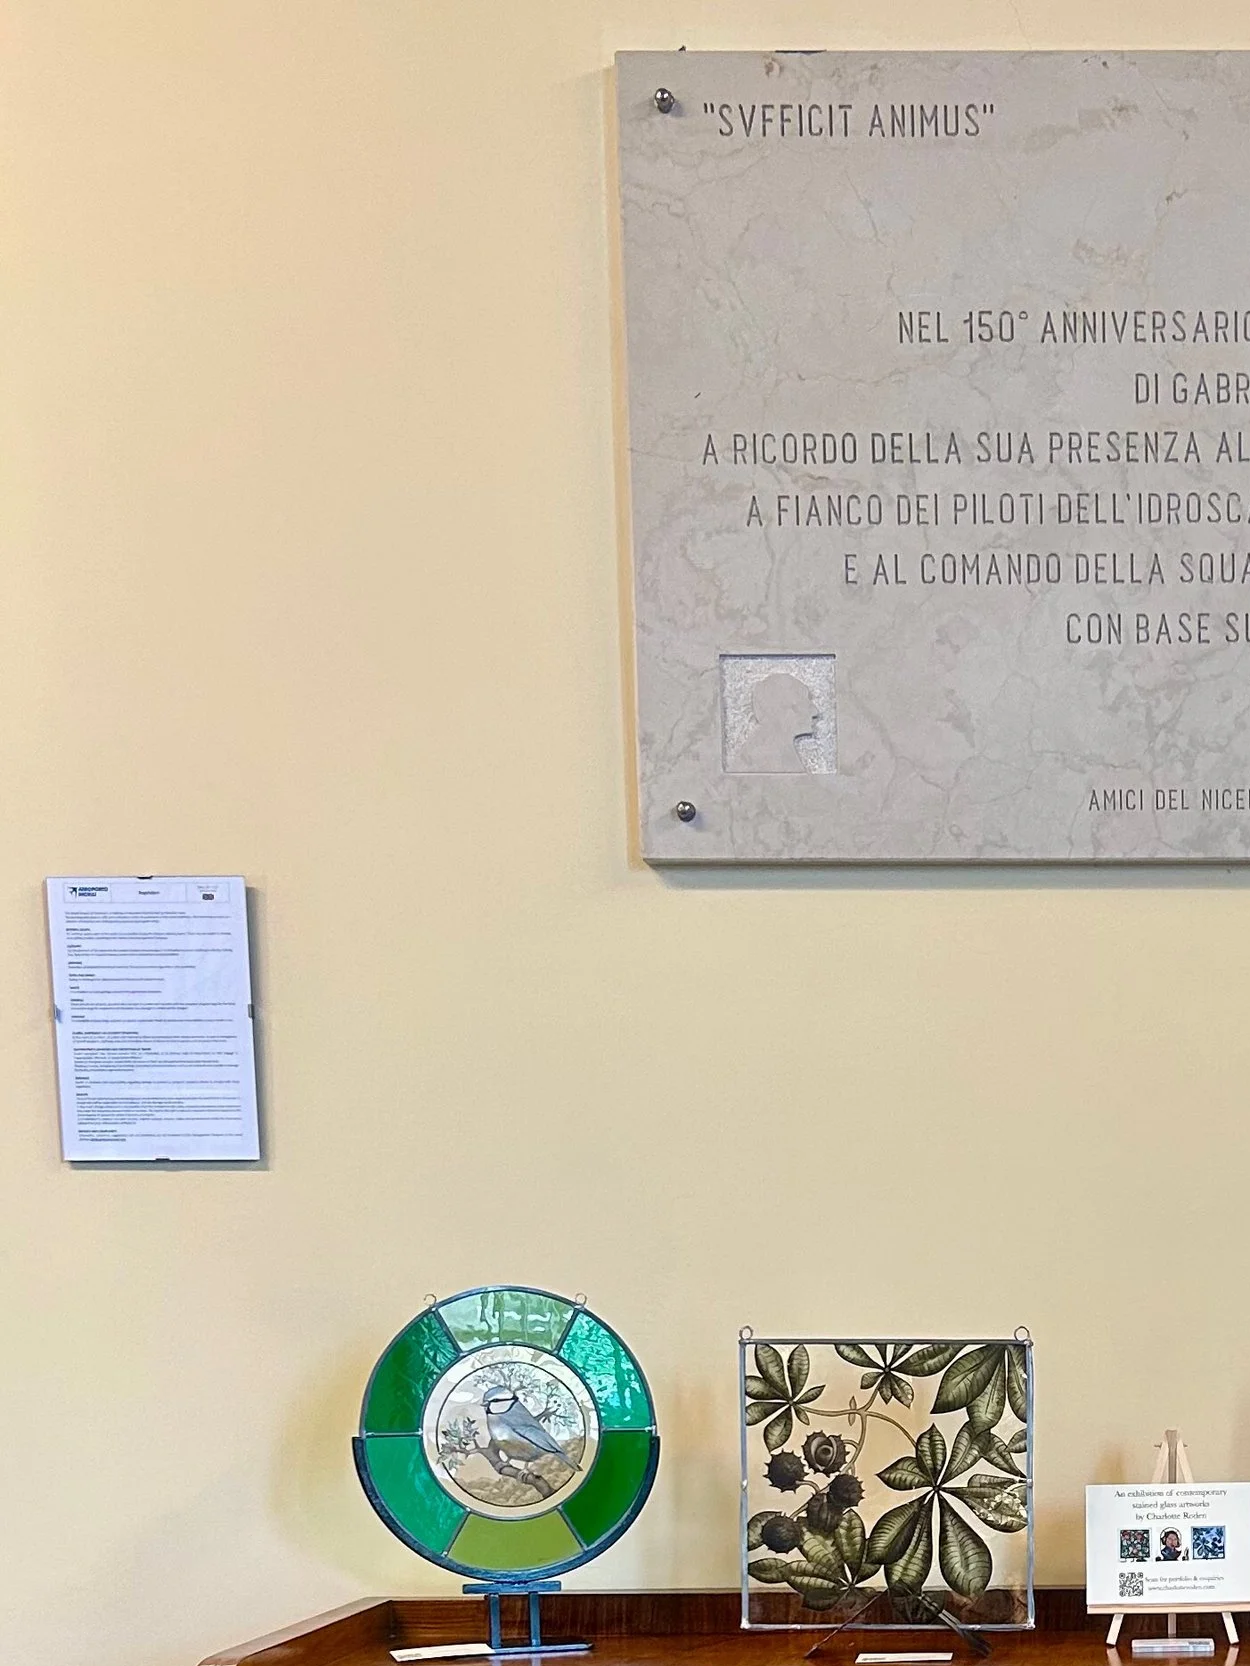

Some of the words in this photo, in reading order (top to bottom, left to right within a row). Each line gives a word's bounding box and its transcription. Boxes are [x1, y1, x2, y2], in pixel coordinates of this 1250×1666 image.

[703, 102, 853, 138] "SVFFICIT
[868, 102, 995, 138] ANIMUS"
[899, 311, 949, 344] NEL
[963, 310, 1029, 344] 150°
[1135, 372, 1159, 405] DI
[702, 433, 719, 466] A
[733, 432, 858, 466] RICORDO
[871, 431, 962, 465] DELLA
[976, 431, 1035, 464] SUA
[1049, 431, 1201, 464] PRESENZA
[1215, 430, 1250, 463] AL
[746, 494, 763, 527] A
[777, 493, 883, 527] FIANCO
[896, 492, 939, 527] DEI
[953, 492, 1044, 525] PILOTI
[844, 553, 858, 585] E
[872, 553, 907, 586] AL
[920, 552, 1062, 586] COMANDO
[1075, 552, 1165, 585] DELLA
[1066, 612, 1123, 645] CON
[1135, 612, 1211, 645] BASE
[1088, 789, 1144, 811] AMICI
[1155, 788, 1191, 811] DEL
[1114, 1490, 1126, 1498] An
[1127, 1490, 1164, 1498] exhibition
[1166, 1489, 1173, 1497] of
[1175, 1489, 1228, 1498] contemporary
[1132, 1501, 1158, 1509] stained
[1160, 1501, 1177, 1510] glass
[1179, 1500, 1210, 1508] artworks
[1135, 1513, 1144, 1522] by
